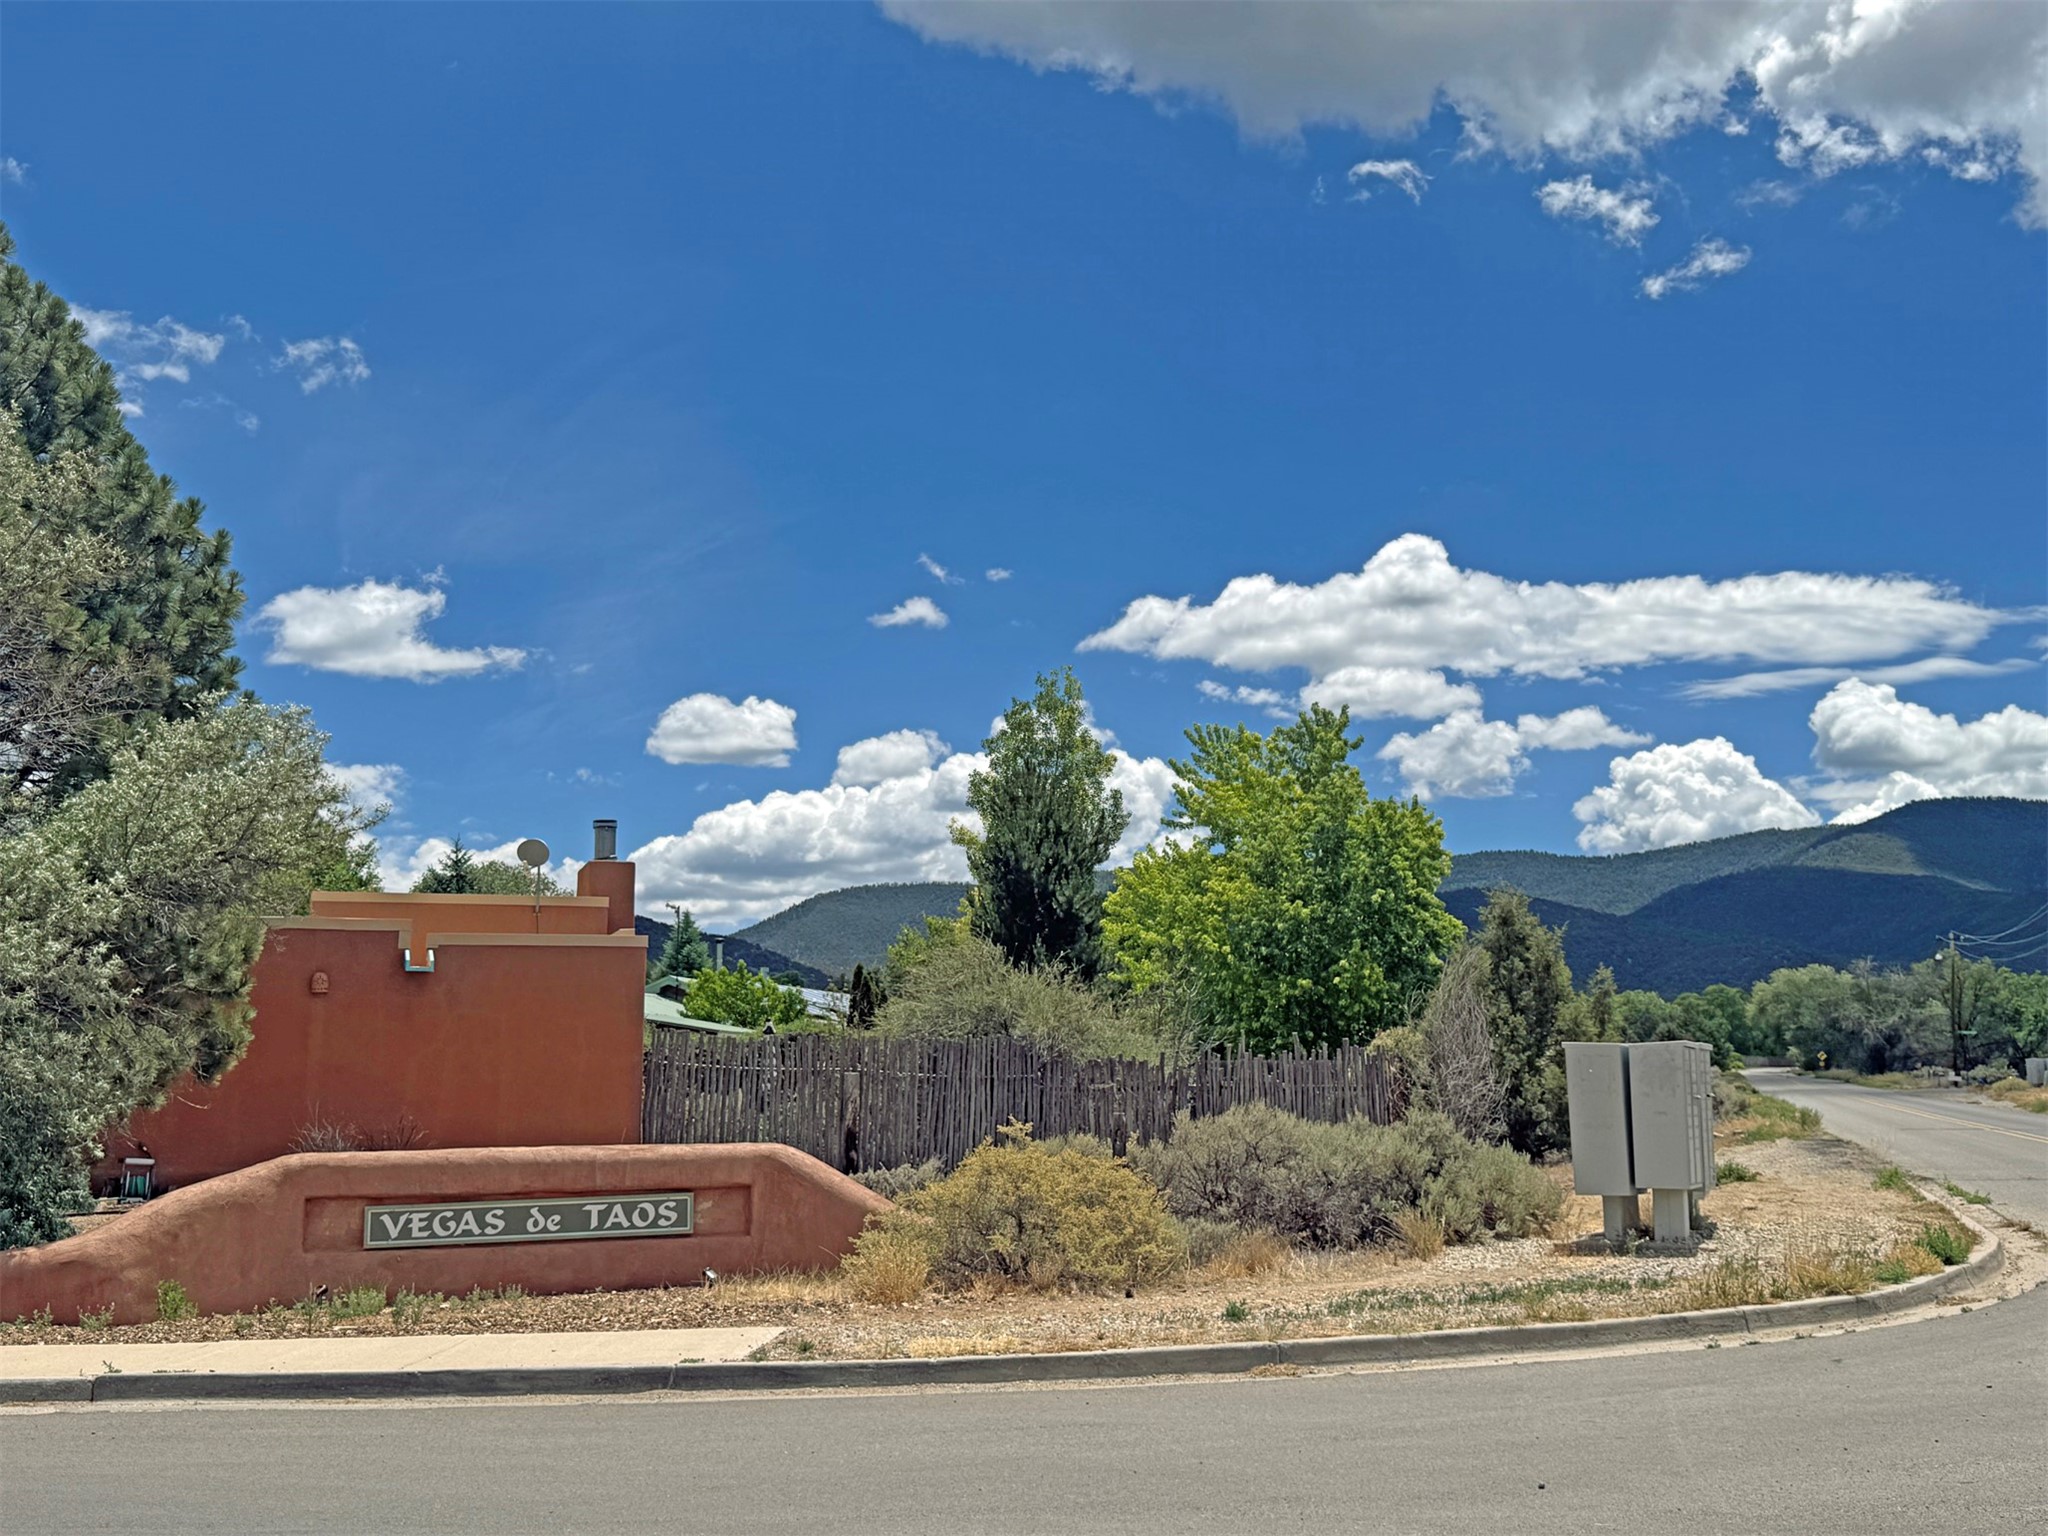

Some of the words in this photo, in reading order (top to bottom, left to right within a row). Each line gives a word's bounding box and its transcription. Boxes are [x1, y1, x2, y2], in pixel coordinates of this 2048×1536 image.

[379, 1209, 505, 1239] VEGAS
[526, 1207, 561, 1233] de
[582, 1201, 678, 1230] TAOS
